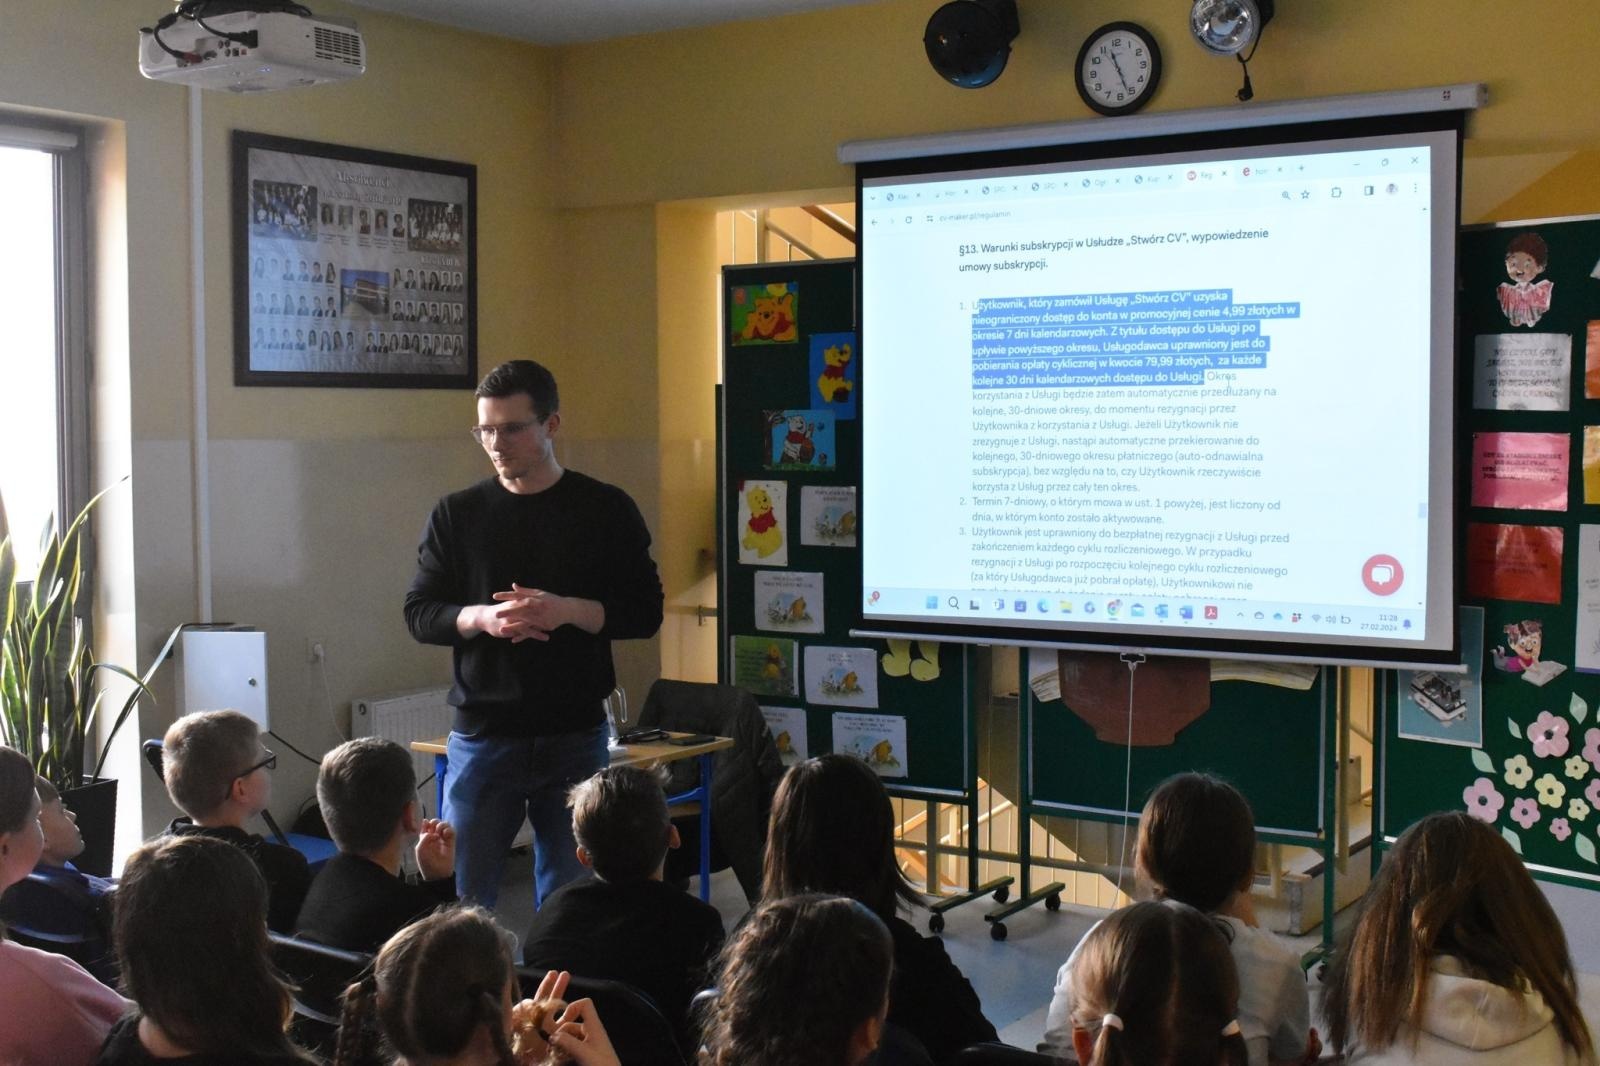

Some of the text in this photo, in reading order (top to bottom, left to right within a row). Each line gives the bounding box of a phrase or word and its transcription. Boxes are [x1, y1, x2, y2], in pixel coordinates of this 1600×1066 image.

[1105, 91, 1111, 99] 7
[981, 241, 1018, 252] Warunki
[1020, 238, 1073, 253] subskrypcji
[1192, 229, 1269, 244] wypowiedzenie
[959, 259, 1048, 274] umowy subskrypcji.
[1030, 298, 1053, 309] który
[1096, 295, 1129, 307] Usługę
[1194, 291, 1228, 303] uzyska
[972, 305, 1284, 326] nieograniczony dostęp do konta promocyjnej cenie 4,99 złotych
[972, 330, 1005, 339] okresie
[1014, 329, 1029, 338] dni
[1032, 327, 1108, 340] kalendarzowych.
[1149, 325, 1190, 337] dostępu
[1192, 324, 1206, 333] do
[1207, 324, 1240, 335] Usługi
[1066, 342, 1101, 353] okresu,
[1105, 341, 1169, 353] Usługodawca
[1171, 340, 1229, 352] uprawniony
[1232, 339, 1250, 350] jest
[1251, 339, 1266, 348] do
[972, 359, 1020, 371] pobierania
[1051, 358, 1097, 370] cyklicznej
[1110, 357, 1143, 366] kwocie
[1145, 357, 1172, 367] 79,99
[1175, 356, 1214, 368] złotych,
[974, 376, 1004, 387] kolejne
[1006, 375, 1018, 384] 30
[1019, 375, 1035, 384] dni
[1038, 374, 1111, 386] kalendarzowych
[1113, 373, 1153, 385] dostępu
[1154, 373, 1168, 382] do
[1207, 372, 1237, 381] Okres
[972, 390, 1023, 402] korzystania
[1032, 390, 1061, 401] Usługi
[1063, 389, 1094, 401] będzie
[1096, 389, 1125, 398] zatem
[1128, 388, 1198, 400] automatycznie
[1009, 405, 1057, 414] 30-dniowe
[1109, 405, 1155, 414] momentu
[1158, 404, 1207, 415] rezygnacji
[1209, 406, 1236, 415] przez
[1038, 420, 1090, 431] korzystania
[1223, 420, 1239, 428] nie
[972, 436, 1020, 447] zrezygnuje
[1028, 436, 1060, 447] Usługi,
[1099, 436, 1166, 447] automatyczne
[1169, 436, 1244, 447] przekierowanie
[1246, 436, 1260, 445] do
[972, 451, 1264, 463] kolejnego, 30-dniowego okresu płatniczego (auto-odnawialna
[1034, 467, 1050, 475] bez
[1051, 467, 1090, 478] względu
[1121, 469, 1137, 478] czy
[1198, 467, 1261, 478] rzeczywiście
[972, 482, 1140, 494] korzysta Usług przez cały ten okres.
[972, 496, 1003, 505] Termin
[1005, 497, 1048, 508] 7-dniowy,
[1058, 498, 1092, 509] którym
[1164, 499, 1206, 510] powyżej,
[1209, 500, 1228, 510] jest
[1230, 500, 1265, 511] liczony
[972, 512, 994, 522] dnia,
[1006, 512, 1037, 524] którym
[1039, 513, 1065, 522] konto
[1067, 513, 1101, 522] zostało
[1025, 528, 1041, 539] jest
[1044, 528, 1097, 540] uprawniony
[1114, 530, 1162, 541] bezpłatnej
[1165, 531, 1214, 542] rezygnacji
[1225, 532, 1257, 543] Usługi
[1260, 533, 1290, 544] przed
[972, 542, 1035, 552] zakończeniem
[1037, 543, 1076, 555] każdego
[1077, 544, 1102, 556] cyklu
[1199, 547, 1252, 559] przypadku
[971, 556, 1288, 577] rezygnacji Usługi rozpoczęciu kolejnego cyklu rozliczeniowego
[971, 572, 984, 583] (za
[986, 572, 1009, 583] który
[1010, 573, 1072, 585] Usługodawca
[1075, 575, 1088, 586] już
[1090, 575, 1120, 587] pobrał
[1237, 579, 1253, 588] nie
